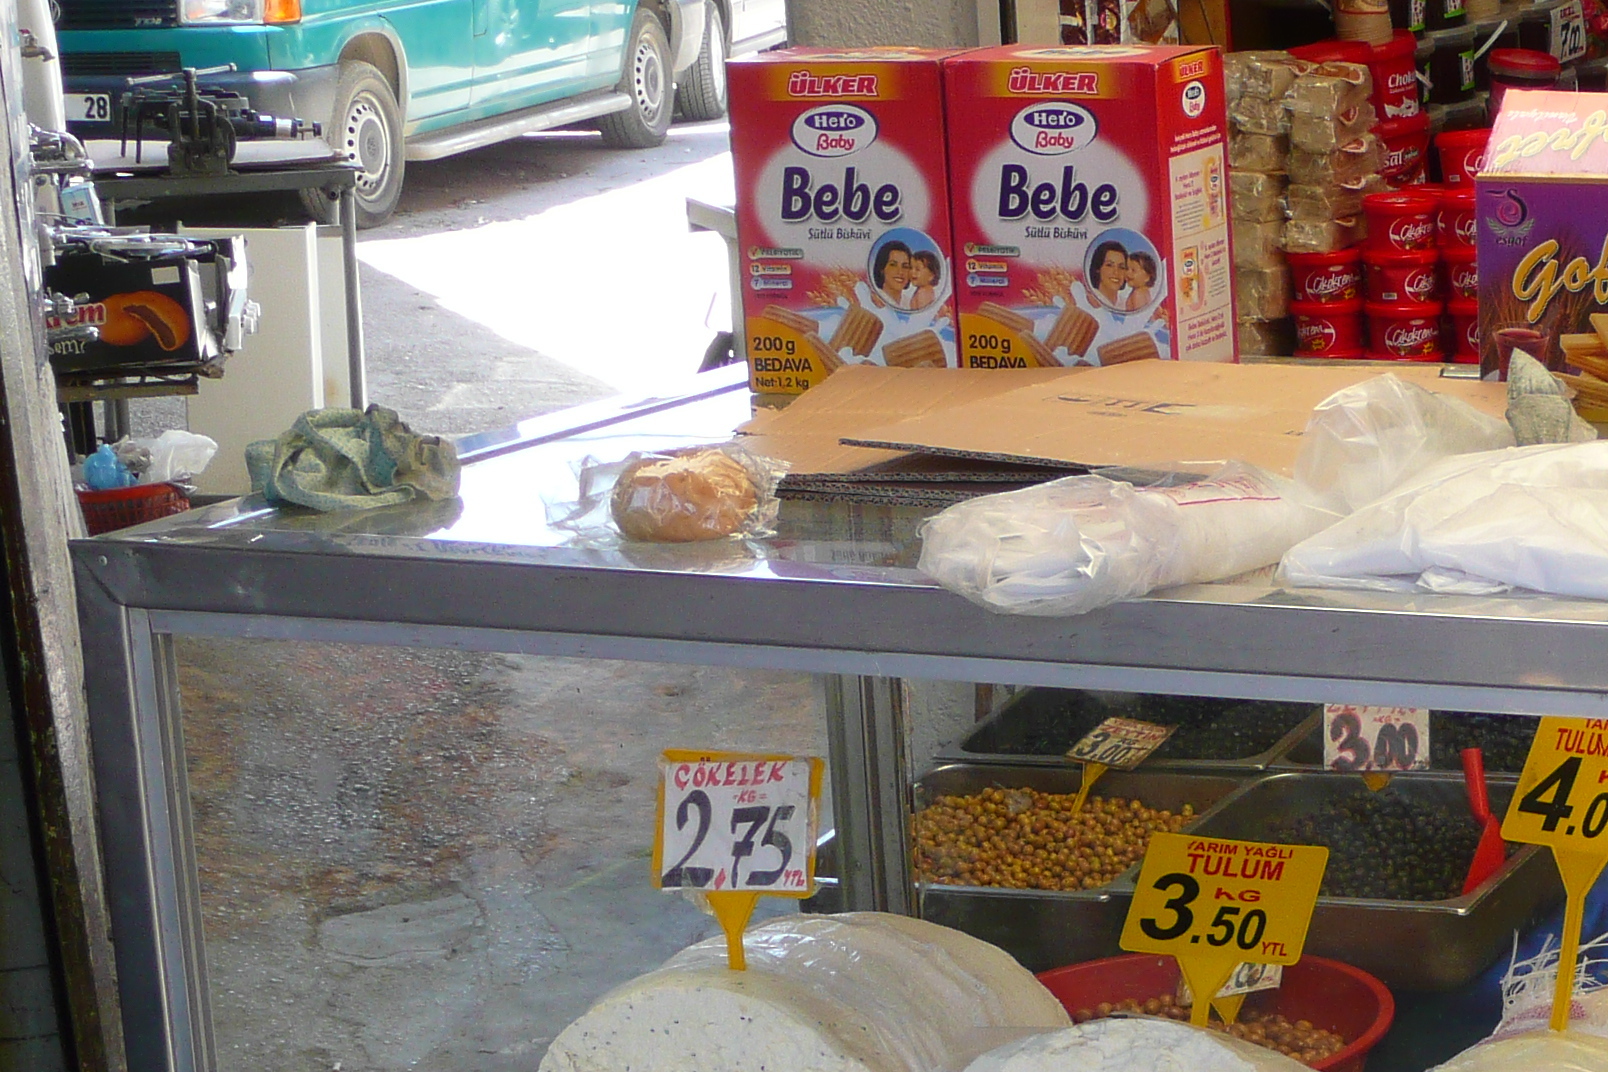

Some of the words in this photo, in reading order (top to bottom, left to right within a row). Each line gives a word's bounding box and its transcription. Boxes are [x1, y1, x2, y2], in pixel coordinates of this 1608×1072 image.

[788, 70, 878, 97] ÜLKER
[1008, 67, 1098, 95] ÜLKER
[84, 97, 108, 119] 28
[814, 112, 856, 128] Hero
[1034, 110, 1076, 126] Hero
[817, 133, 855, 151] Baby
[1035, 131, 1074, 149] Baby
[781, 166, 901, 222] Bebe
[998, 164, 1119, 222] Bebe
[808, 228, 834, 240] Sütlü
[1025, 226, 1051, 239] Sütlü
[753, 337, 783, 352] 200
[786, 339, 796, 355] g
[969, 334, 999, 350] 200
[1001, 338, 1011, 354] g
[754, 358, 813, 372] BEDAVA
[970, 356, 1027, 369] BEDAVA
[1330, 711, 1419, 771] 3.00
[674, 757, 788, 791] ÇÖKELEK
[1187, 841, 1238, 855] YARIM
[1243, 843, 1293, 859] YAĞLI
[1187, 853, 1285, 881] TULUM
[1140, 873, 1267, 950] 3.50
[1261, 941, 1287, 957] YTL
